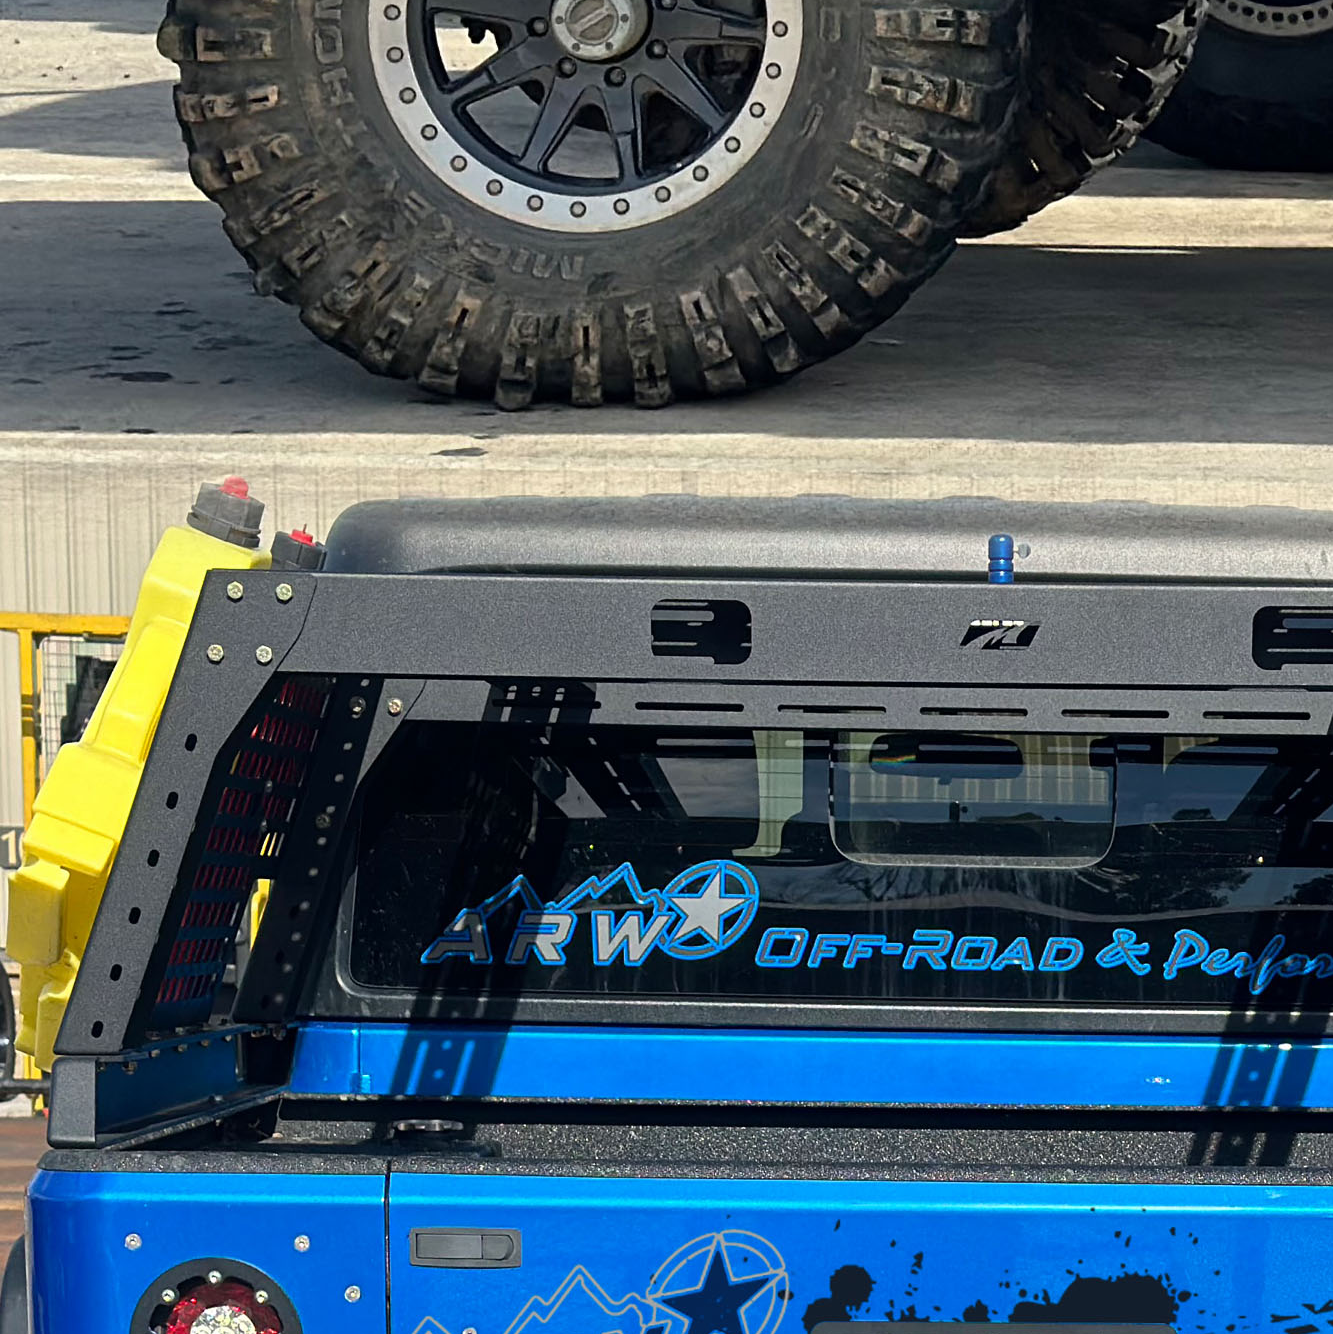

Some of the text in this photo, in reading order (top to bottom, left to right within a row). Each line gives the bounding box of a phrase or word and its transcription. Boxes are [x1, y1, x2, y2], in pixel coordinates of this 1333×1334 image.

[1, 829, 24, 864] 1
[420, 908, 676, 966] ARW
[755, 927, 1084, 972] OFF-ROAD
[1095, 928, 1152, 978] &
